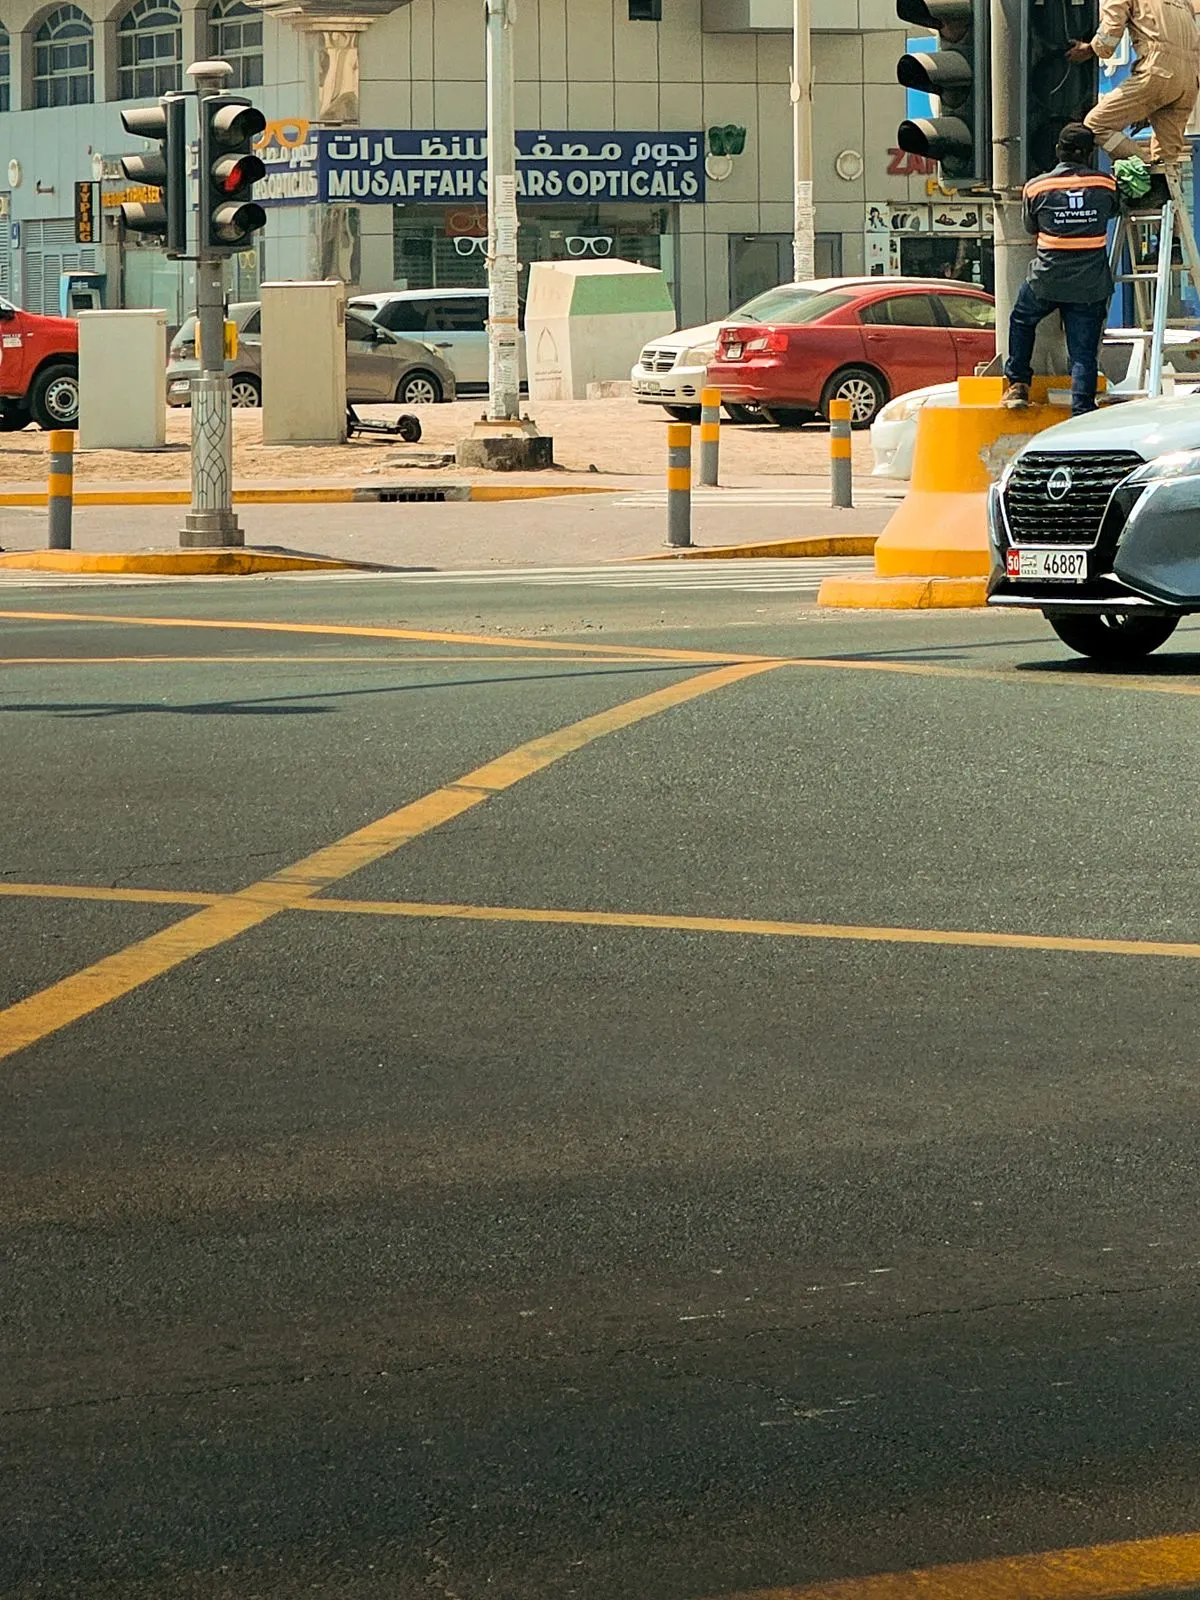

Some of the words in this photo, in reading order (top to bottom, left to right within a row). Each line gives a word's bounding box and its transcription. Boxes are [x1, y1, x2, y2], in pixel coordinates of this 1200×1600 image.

[514, 135, 622, 161] مصف
[632, 137, 698, 167] نجوم
[328, 169, 474, 197] MUSAFFAH
[566, 169, 699, 197] OPTICALS
[1047, 480, 1072, 489] NISSAN
[1007, 554, 1019, 571] 50
[1043, 553, 1084, 575] 46887
